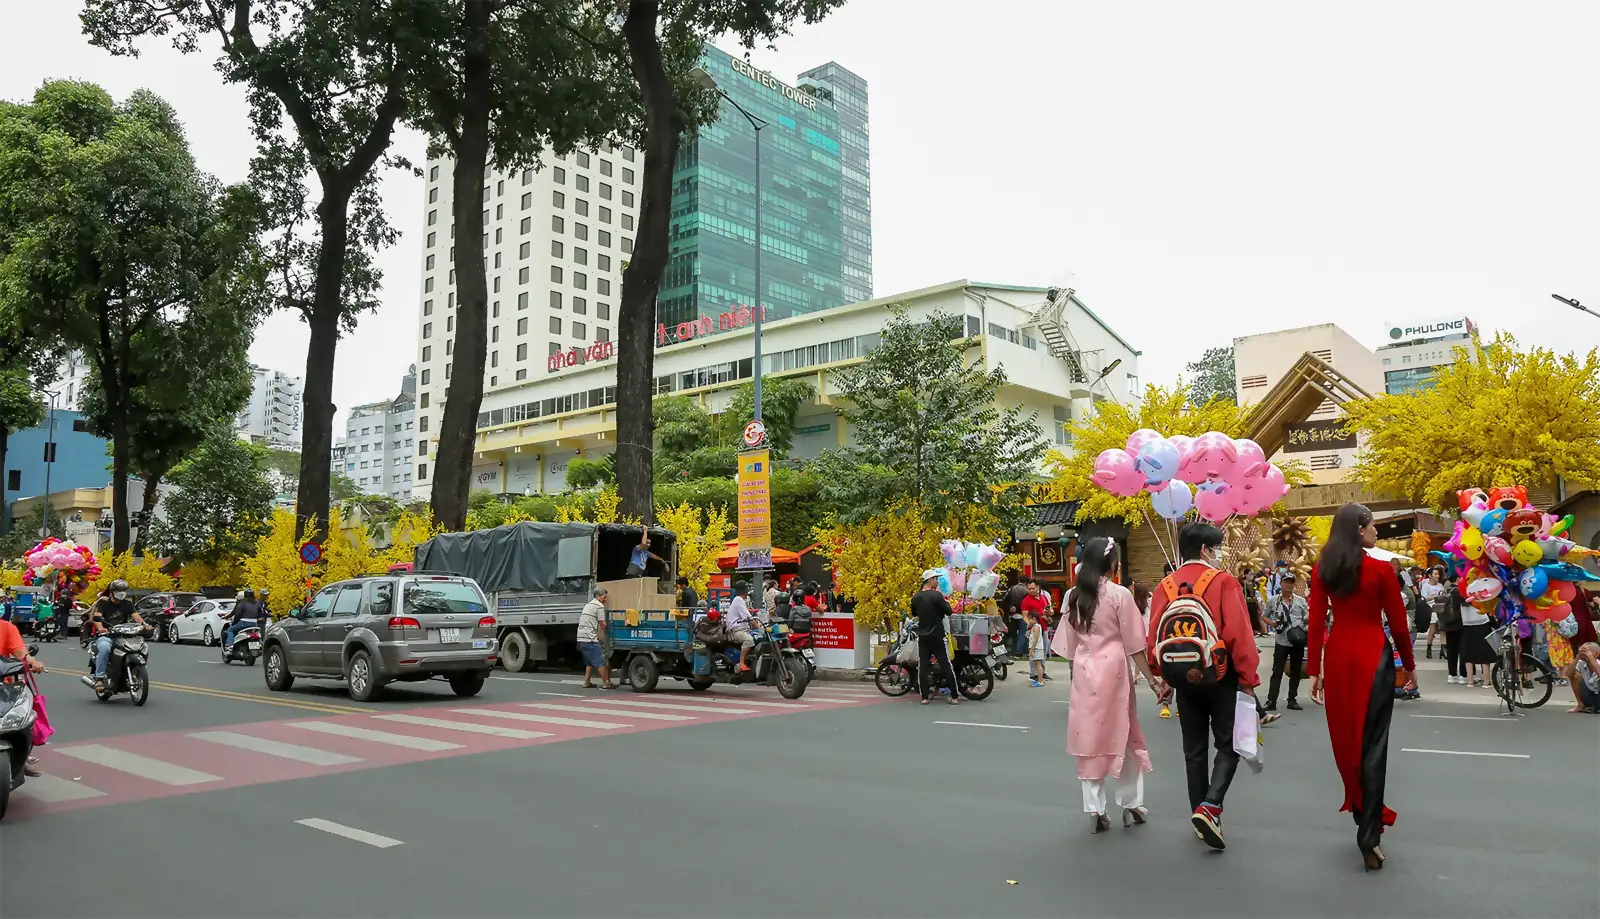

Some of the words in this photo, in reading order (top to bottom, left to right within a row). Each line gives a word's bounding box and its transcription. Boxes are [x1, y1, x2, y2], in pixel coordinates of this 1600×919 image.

[731, 58, 777, 90] CENTEC
[779, 82, 817, 112] TOWER
[1405, 320, 1463, 335] PHULONG
[547, 345, 577, 373] nhà
[582, 338, 614, 361] văn
